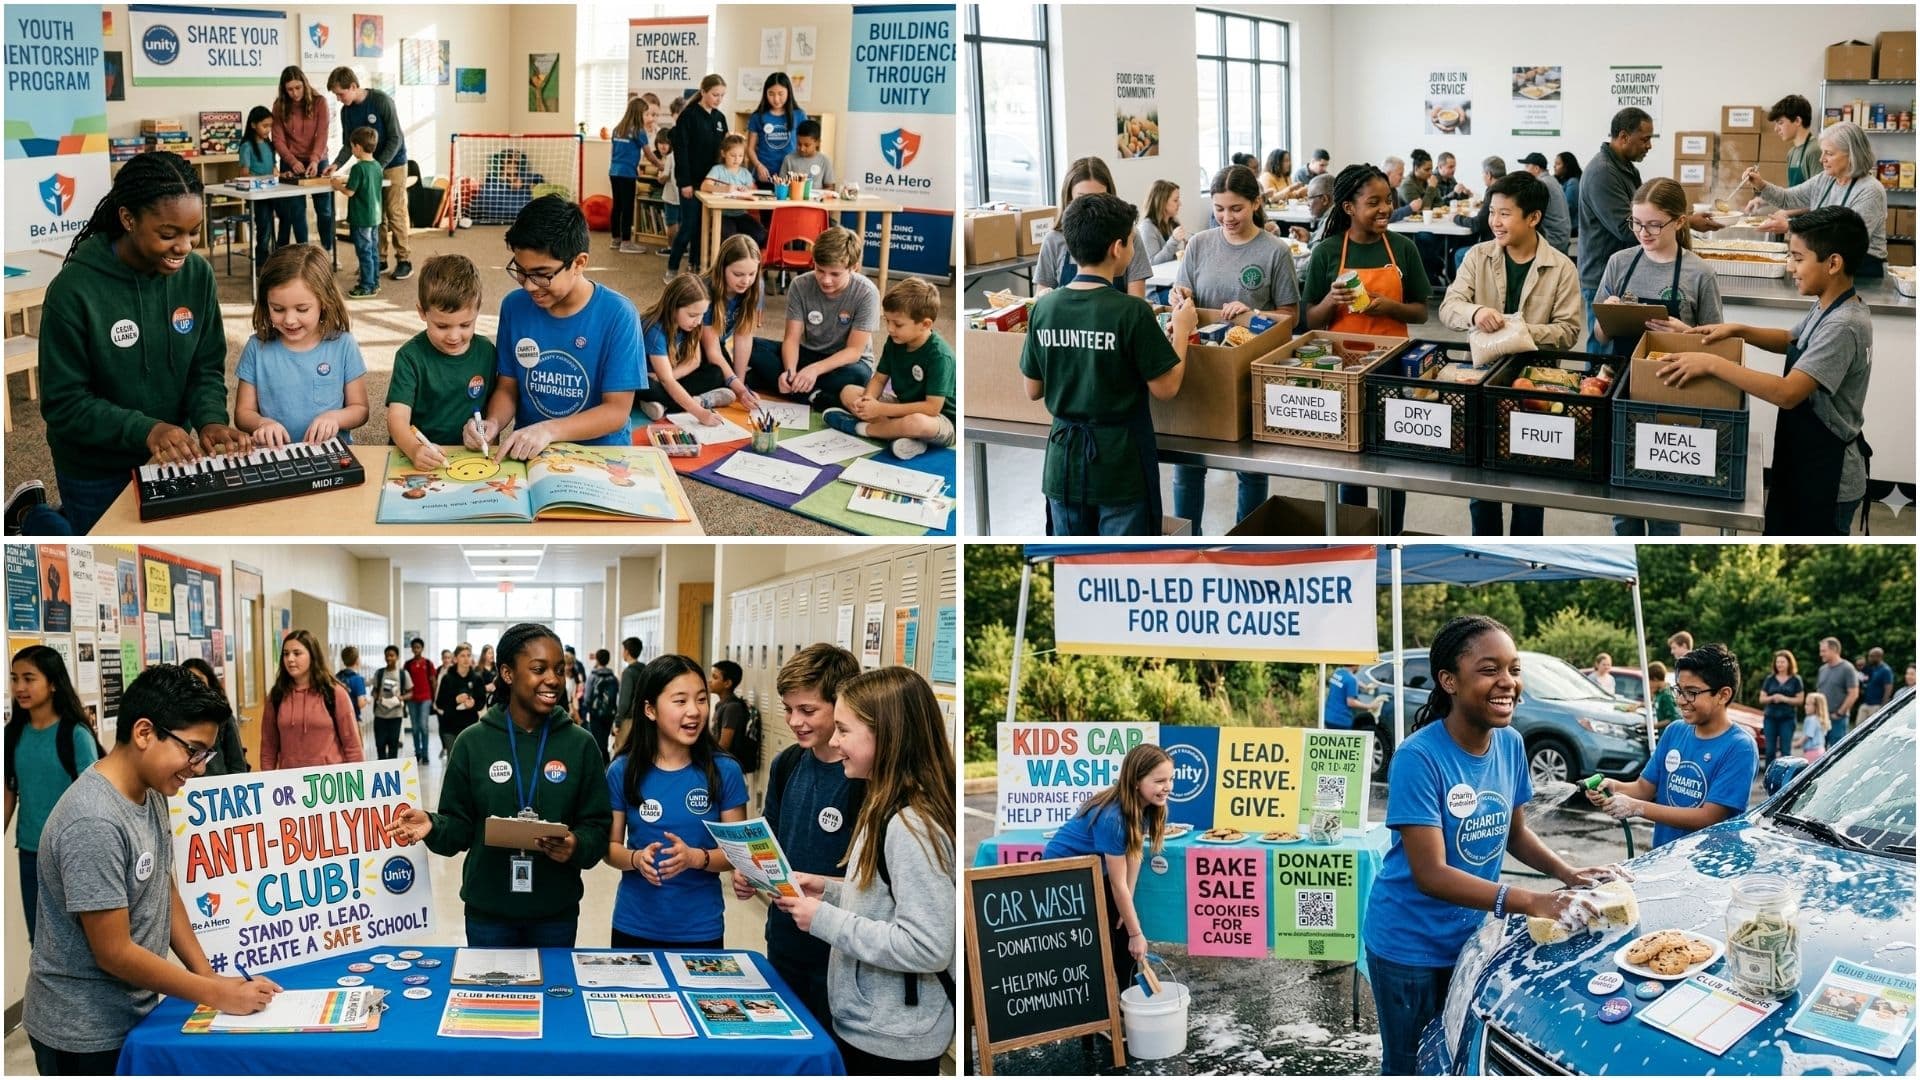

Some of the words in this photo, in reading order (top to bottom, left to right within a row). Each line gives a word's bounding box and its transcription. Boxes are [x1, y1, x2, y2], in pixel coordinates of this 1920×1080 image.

[18, 18, 74, 41] YOUTH
[187, 25, 237, 44] SHARE
[240, 27, 278, 45] YOUR
[869, 21, 950, 40] BUILDING
[145, 38, 177, 53] unity
[636, 32, 700, 47] EMPOWER.
[208, 48, 262, 66] SKILLS!
[646, 49, 688, 63] TEACH.
[9, 71, 91, 91] PROGRAM
[641, 67, 691, 81] INSPIRE.
[866, 65, 946, 83] THROUGH
[1117, 73, 1132, 84] FOOD
[1429, 72, 1445, 82] JOIN
[1447, 72, 1458, 82] US
[1459, 72, 1468, 82] IN
[1615, 73, 1657, 84] SATURDAY
[879, 87, 931, 105] UNITY
[1117, 86, 1156, 98] COMMUNITY
[1430, 83, 1466, 95] SERVICE
[1611, 84, 1660, 95] COMMUNITY
[1618, 96, 1653, 106] KITCHEN
[865, 172, 882, 184] Be
[885, 174, 895, 186] A
[898, 174, 931, 188] Hero
[30, 224, 47, 237] Be
[49, 222, 58, 234] A
[1036, 329, 1116, 350] VOLUNTEER
[530, 369, 583, 388] CHARITY
[529, 382, 584, 399] FUNDRAISER
[1280, 393, 1325, 408] CANNED
[1269, 405, 1338, 422] VEGETABLES
[1404, 406, 1432, 421] DRY
[1394, 420, 1442, 438] GOODS
[1521, 427, 1563, 444] FRUIT
[1654, 431, 1697, 448] MEAL
[1649, 447, 1701, 466] PACKS
[312, 478, 332, 489] MIDI
[1078, 577, 1193, 603] CHILD-LED
[1202, 576, 1353, 605] FUNDRAISER
[1128, 609, 1169, 633] FOR
[1176, 609, 1220, 634] OUR
[1227, 610, 1301, 636] CAUSE
[1012, 728, 1079, 756] KIDS
[1087, 727, 1144, 756] CAR
[1310, 735, 1362, 748] DONATE
[1230, 742, 1290, 763] LEAD.
[1309, 748, 1360, 761] ONLINE:
[1026, 759, 1119, 787] WASH:
[1173, 764, 1203, 783] nity
[1311, 761, 1325, 772] QR
[1222, 769, 1296, 791] SERVE.
[1671, 774, 1703, 791] CHARITY
[187, 782, 264, 826] START
[272, 785, 296, 806] OR
[302, 769, 365, 809] JOIN
[371, 770, 402, 799] AN
[1007, 791, 1069, 804] FUNDRAISE
[1451, 791, 1473, 801] Charity
[1007, 808, 1042, 823] HELP
[1046, 807, 1072, 822] THE
[1230, 796, 1286, 818] GIVE.
[1465, 811, 1507, 831] CHARITY
[1460, 824, 1508, 843] FUNDRAISER
[1196, 857, 1257, 877] BAKE
[1278, 853, 1353, 869] DONATE
[383, 867, 412, 882] Unity
[1279, 871, 1353, 887] ONLINE:
[257, 858, 361, 917] CLUB!
[1198, 880, 1255, 899] SALE
[983, 890, 1027, 927] CAR
[1030, 883, 1086, 924] WASH
[1194, 904, 1260, 917] COOKIES
[204, 920, 210, 929] A
[211, 918, 230, 927] Hero
[238, 919, 294, 947] STAND
[299, 912, 322, 933] UP.
[327, 903, 374, 927] LEAD.
[1212, 918, 1242, 931] FOR
[210, 952, 229, 973] #
[234, 938, 301, 968] CREATE
[306, 935, 319, 954] A
[322, 924, 363, 951] SAFE
[367, 906, 429, 940] SCHOOL!
[1070, 927, 1093, 948] $10
[1203, 931, 1252, 945] CAUSE
[1062, 964, 1090, 982] OUR
[1696, 975, 1724, 992] CLUB
[485, 992, 536, 1000] MEMBERS
[1006, 983, 1090, 1017] COMMUNITY!
